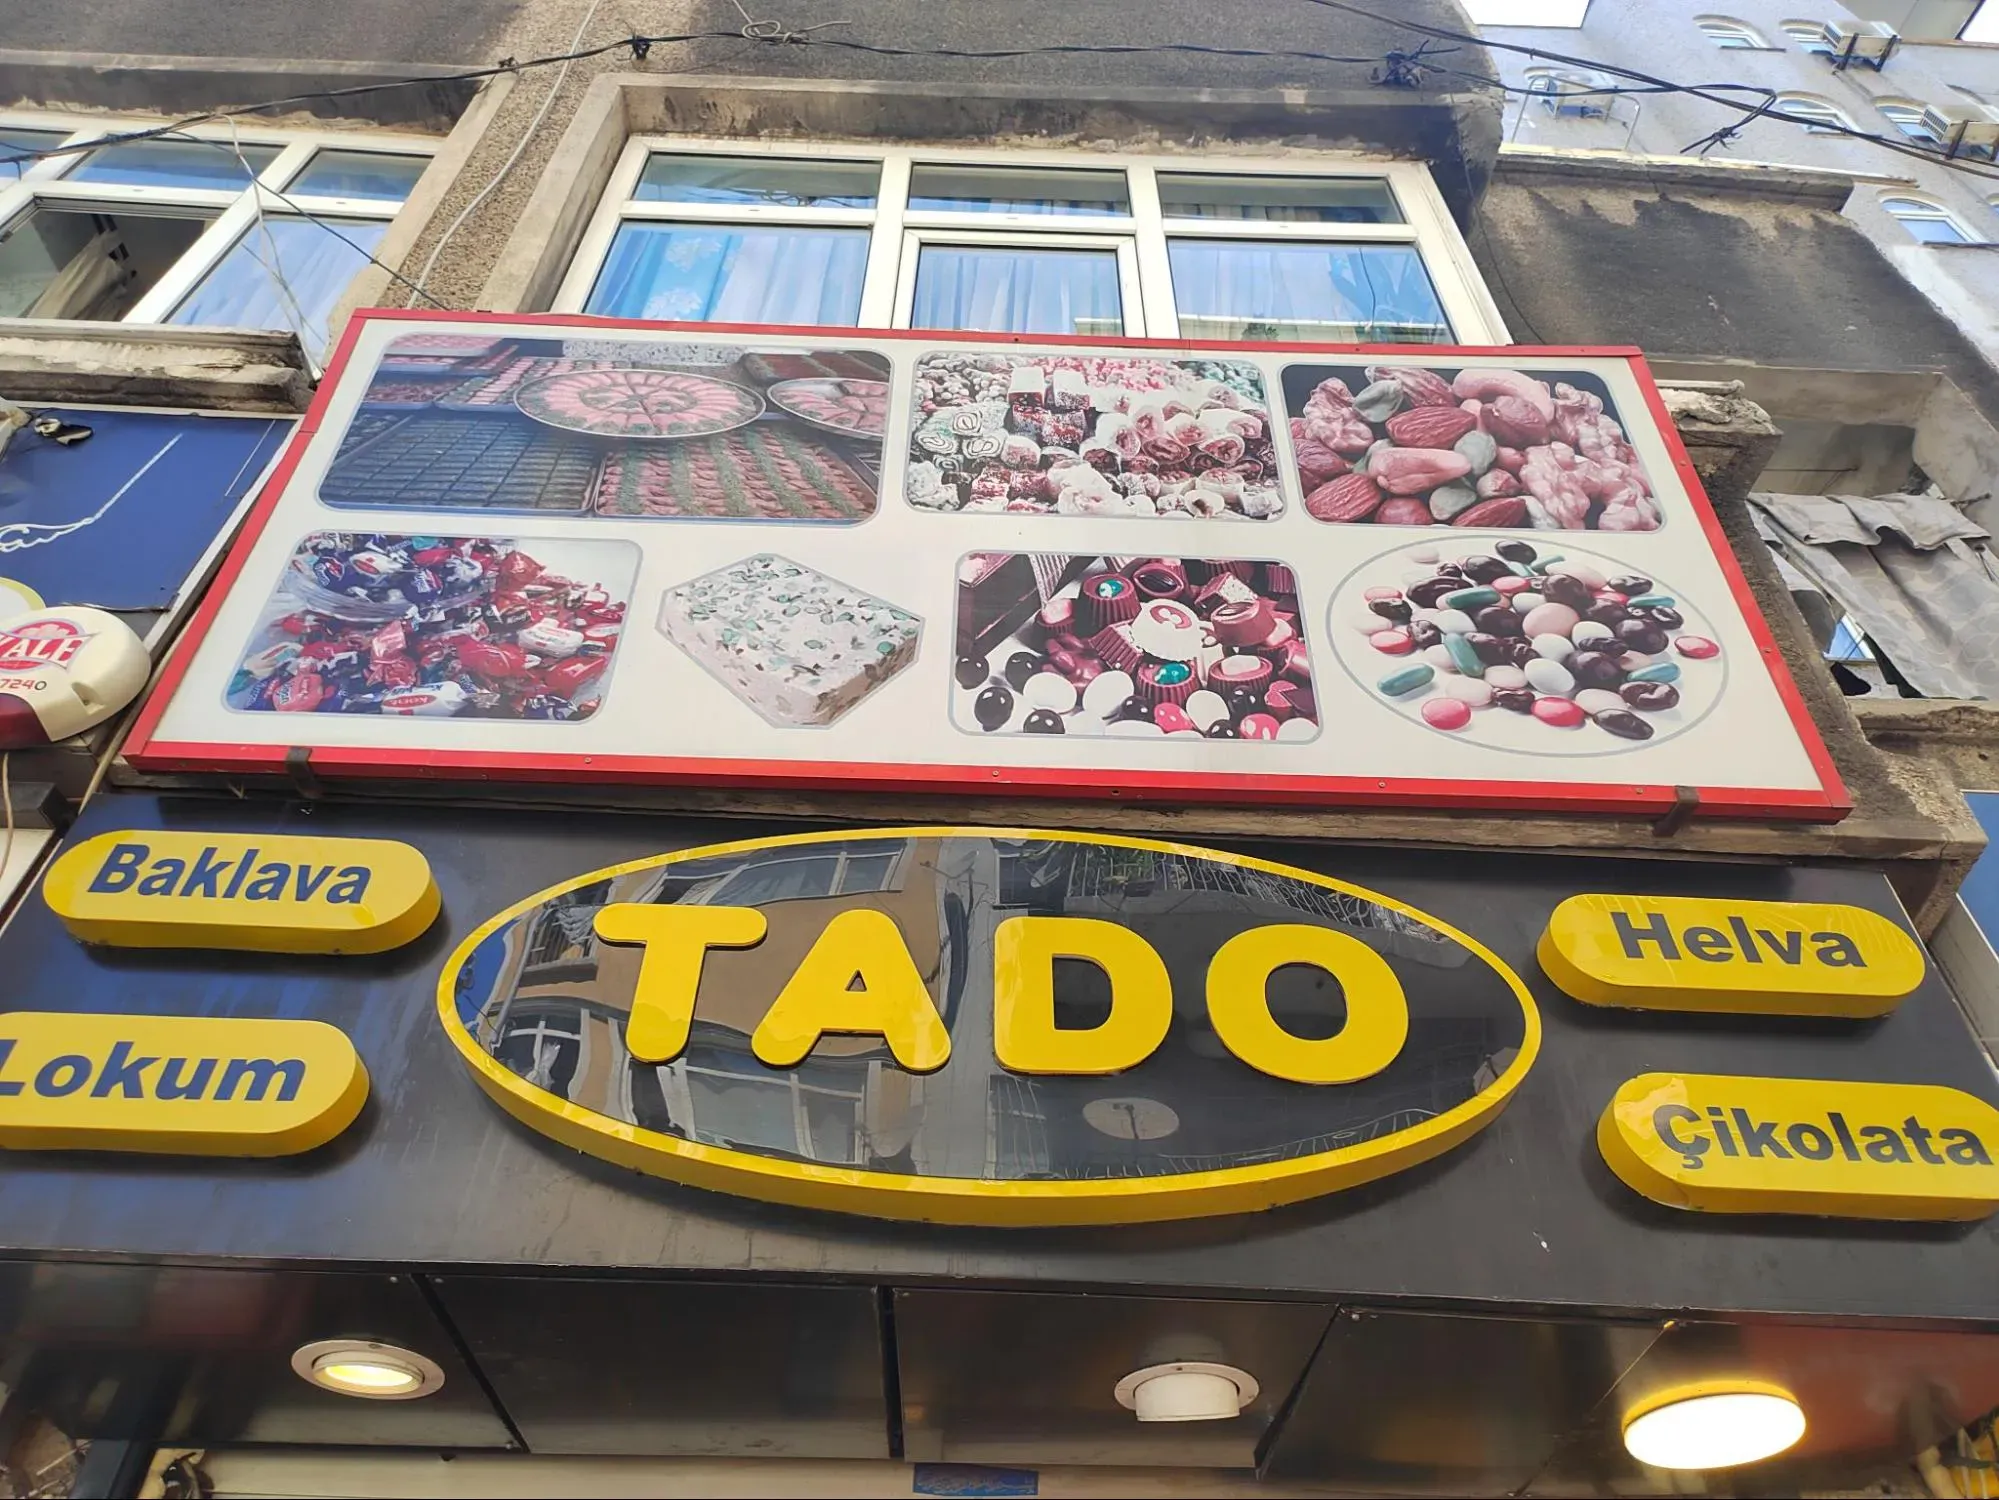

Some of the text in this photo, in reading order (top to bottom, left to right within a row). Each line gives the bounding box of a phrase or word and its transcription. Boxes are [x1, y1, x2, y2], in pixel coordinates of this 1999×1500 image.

[0, 634, 84, 668] ALE
[87, 843, 372, 905] Baklava
[1611, 911, 1869, 968] Helva
[593, 902, 1410, 1085] TADO
[0, 1038, 307, 1102] Lokum
[1652, 1104, 1994, 1170] Çikolata
